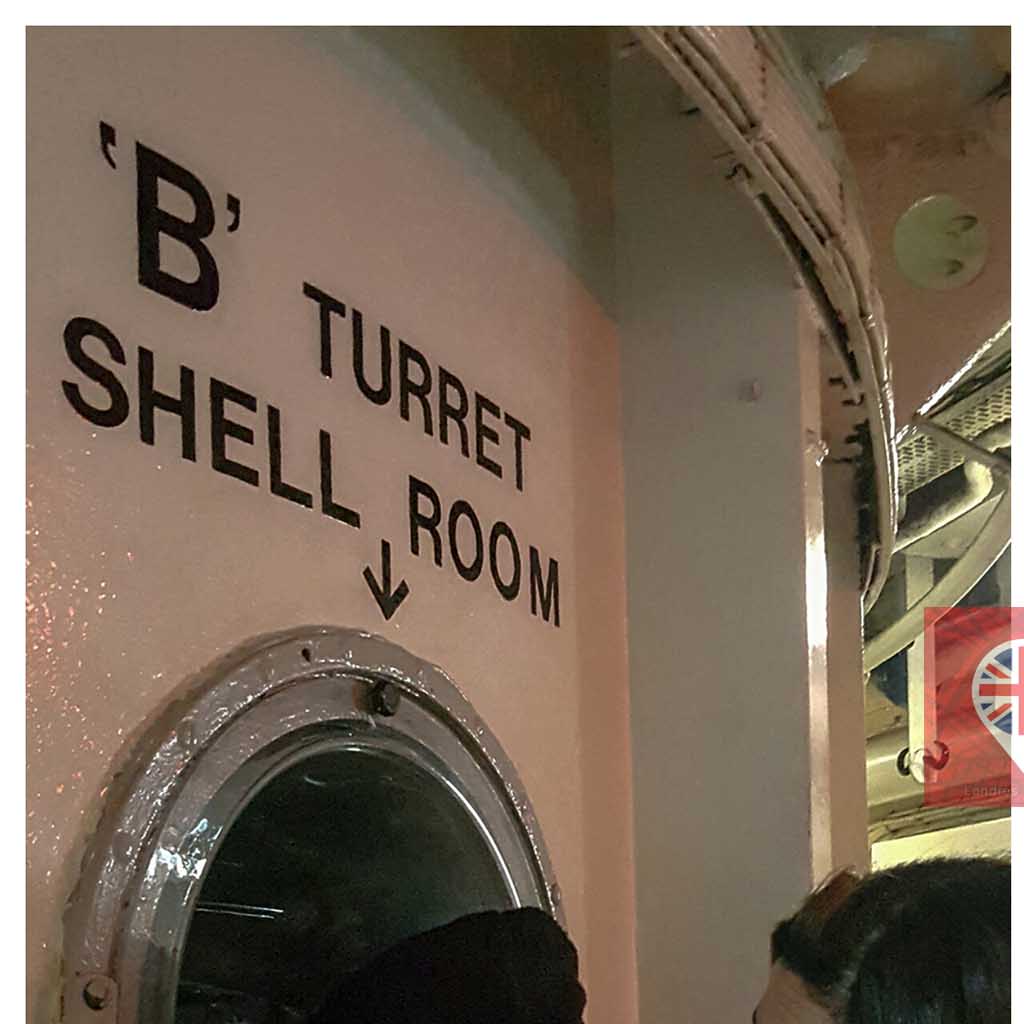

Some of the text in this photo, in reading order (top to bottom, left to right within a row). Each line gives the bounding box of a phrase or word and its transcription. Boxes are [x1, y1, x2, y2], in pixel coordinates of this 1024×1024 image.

[61, 316, 561, 628] SHELL ROOM
[302, 280, 532, 492] TURRET
